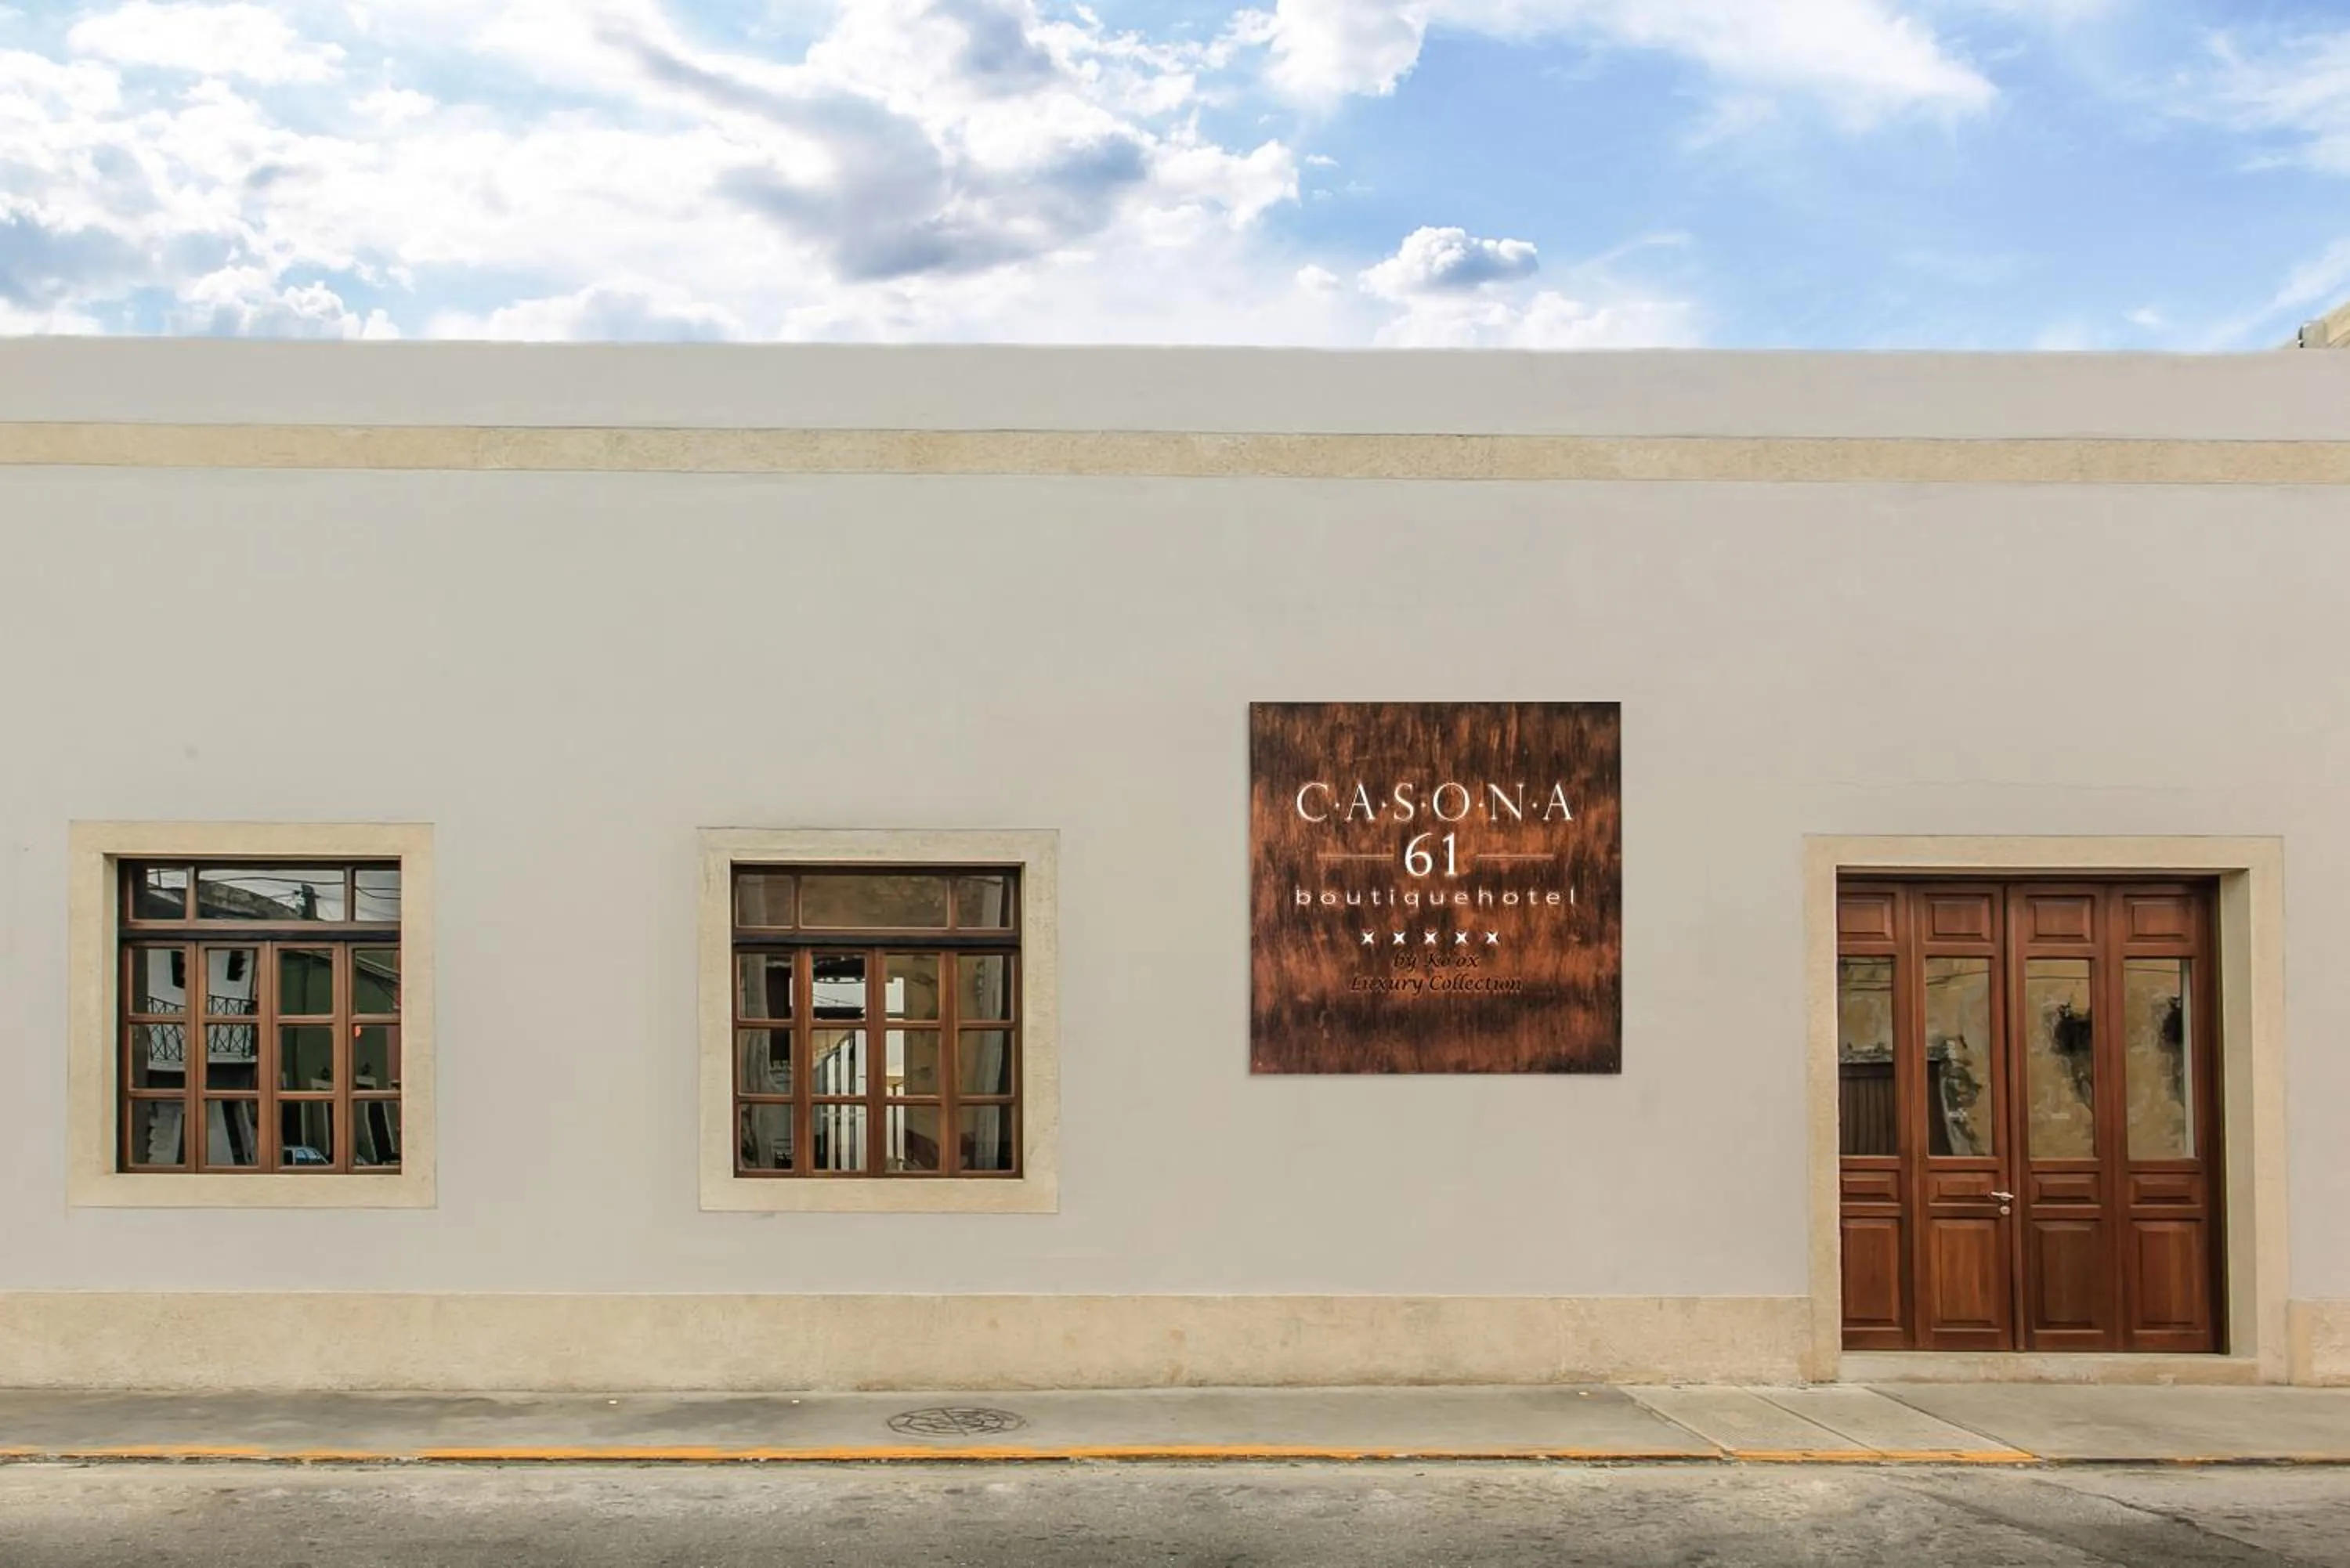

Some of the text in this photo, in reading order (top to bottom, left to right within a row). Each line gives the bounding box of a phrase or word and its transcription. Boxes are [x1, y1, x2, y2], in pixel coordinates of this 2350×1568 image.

[1404, 832, 1458, 877] 61
[1393, 952, 1417, 972] by
[1351, 974, 1522, 995] Luxury Collection
